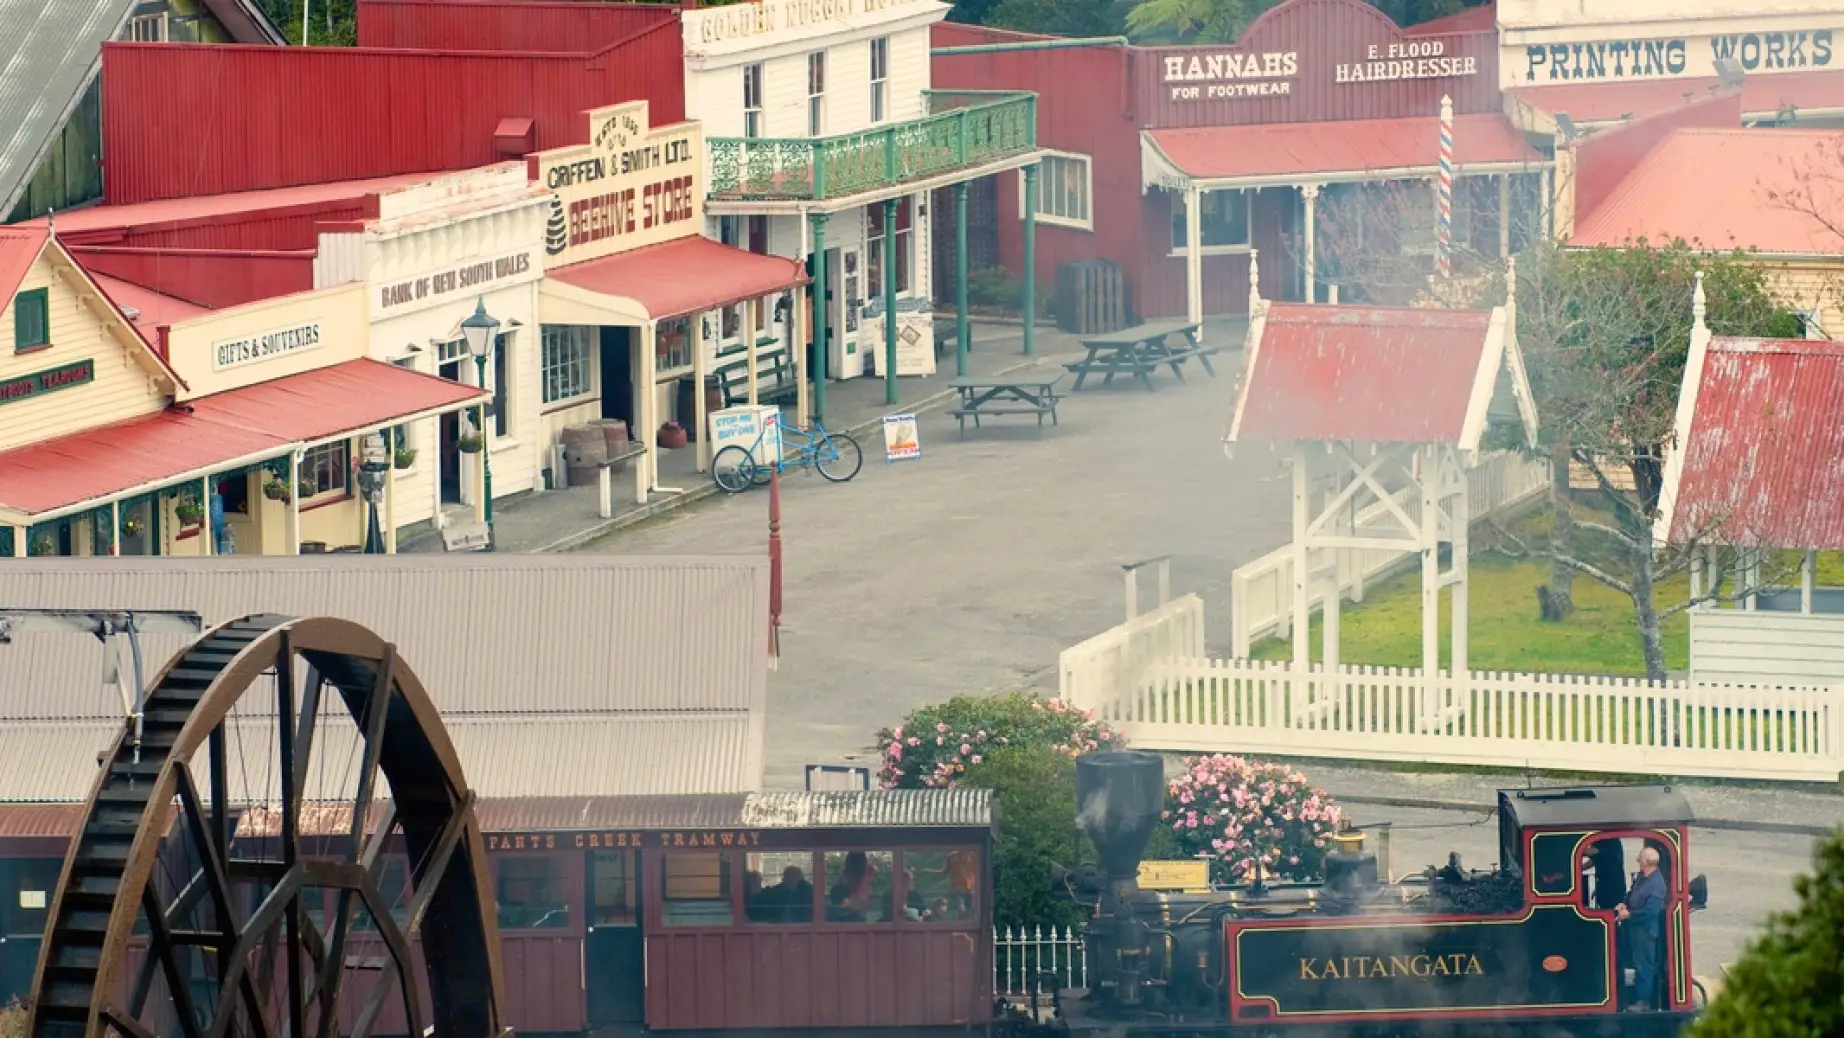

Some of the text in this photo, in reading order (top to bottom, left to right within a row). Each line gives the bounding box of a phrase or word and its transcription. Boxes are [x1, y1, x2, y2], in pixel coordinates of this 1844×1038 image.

[701, 2, 776, 43] GOLDEN
[1164, 51, 1297, 81] HANNAHS
[1367, 41, 1444, 60] E. FLOOD
[1526, 28, 1833, 81] PRINTING WORKS
[1336, 56, 1477, 83] HAIRDRESSER
[1171, 82, 1291, 99] FOR FOOTWEAR
[610, 152, 619, 177] &
[620, 144, 660, 174] SMITH
[665, 138, 693, 165] LTD.
[569, 174, 693, 247] BEEHIVE STORE
[381, 286, 412, 308] BANK
[415, 276, 430, 300] OF
[459, 260, 494, 289] SOUTH
[495, 252, 530, 279] WALES
[217, 323, 319, 366] GIFTS & SOUVENIRS
[575, 832, 643, 848] CREEK
[661, 831, 760, 847] TRAMWAY
[1300, 954, 1484, 980] KAITANGATA
